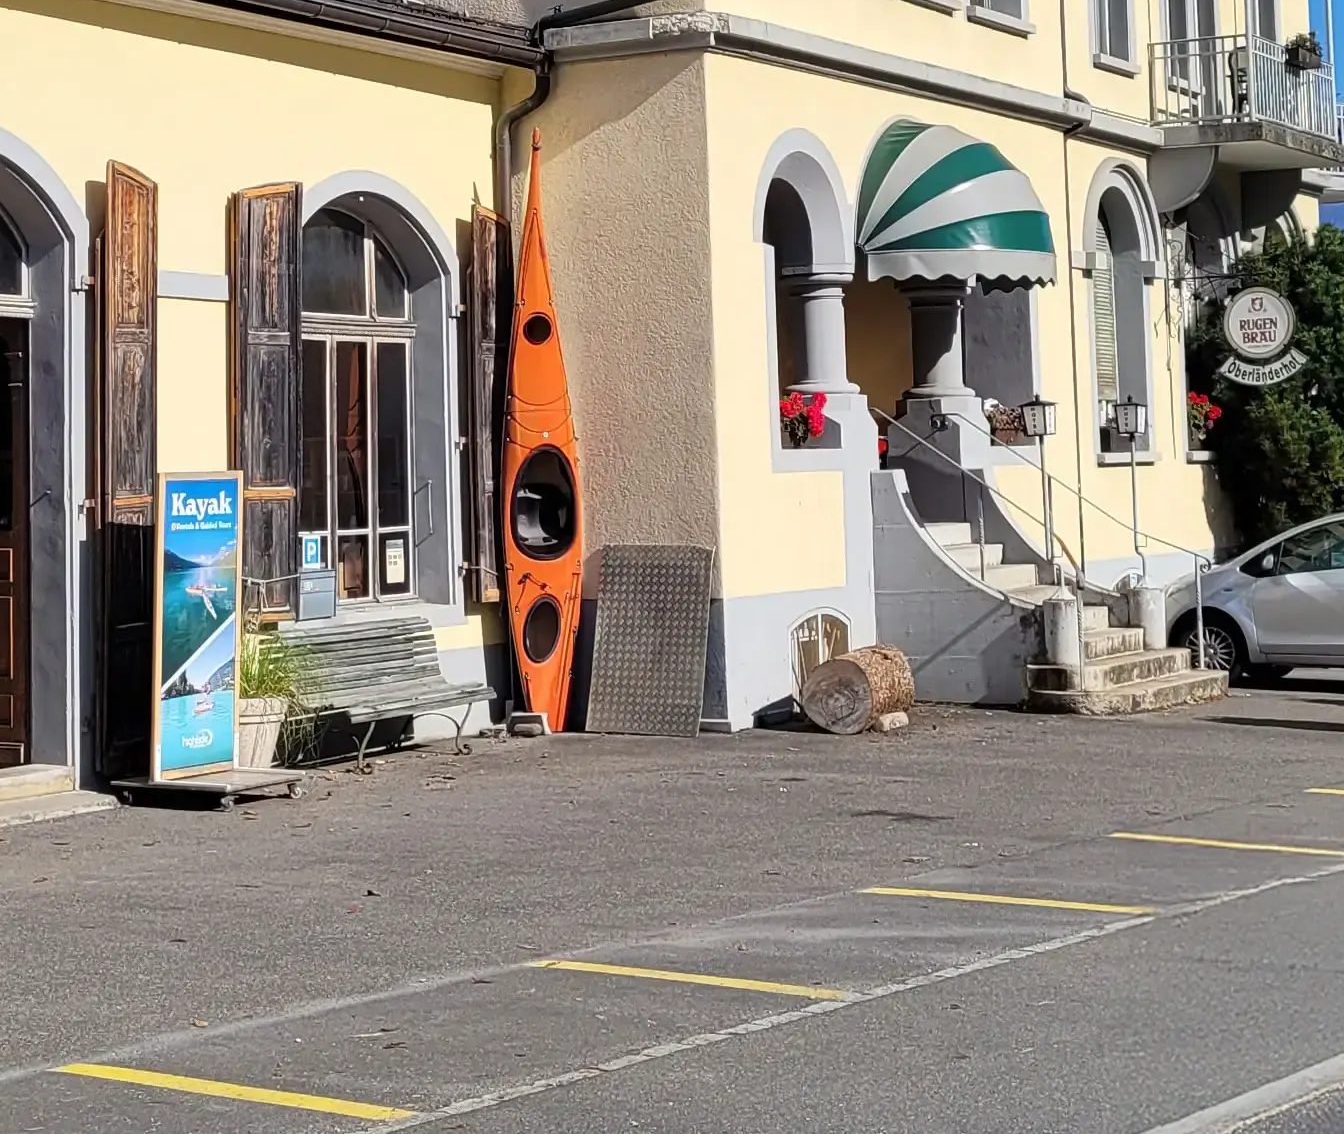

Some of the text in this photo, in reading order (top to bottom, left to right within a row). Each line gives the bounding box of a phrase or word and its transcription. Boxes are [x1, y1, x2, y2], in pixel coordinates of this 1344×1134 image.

[1239, 317, 1278, 331] RUGEN
[1227, 353, 1302, 382] Oberländerhof
[171, 490, 233, 521] Kayak
[306, 541, 317, 562] P
